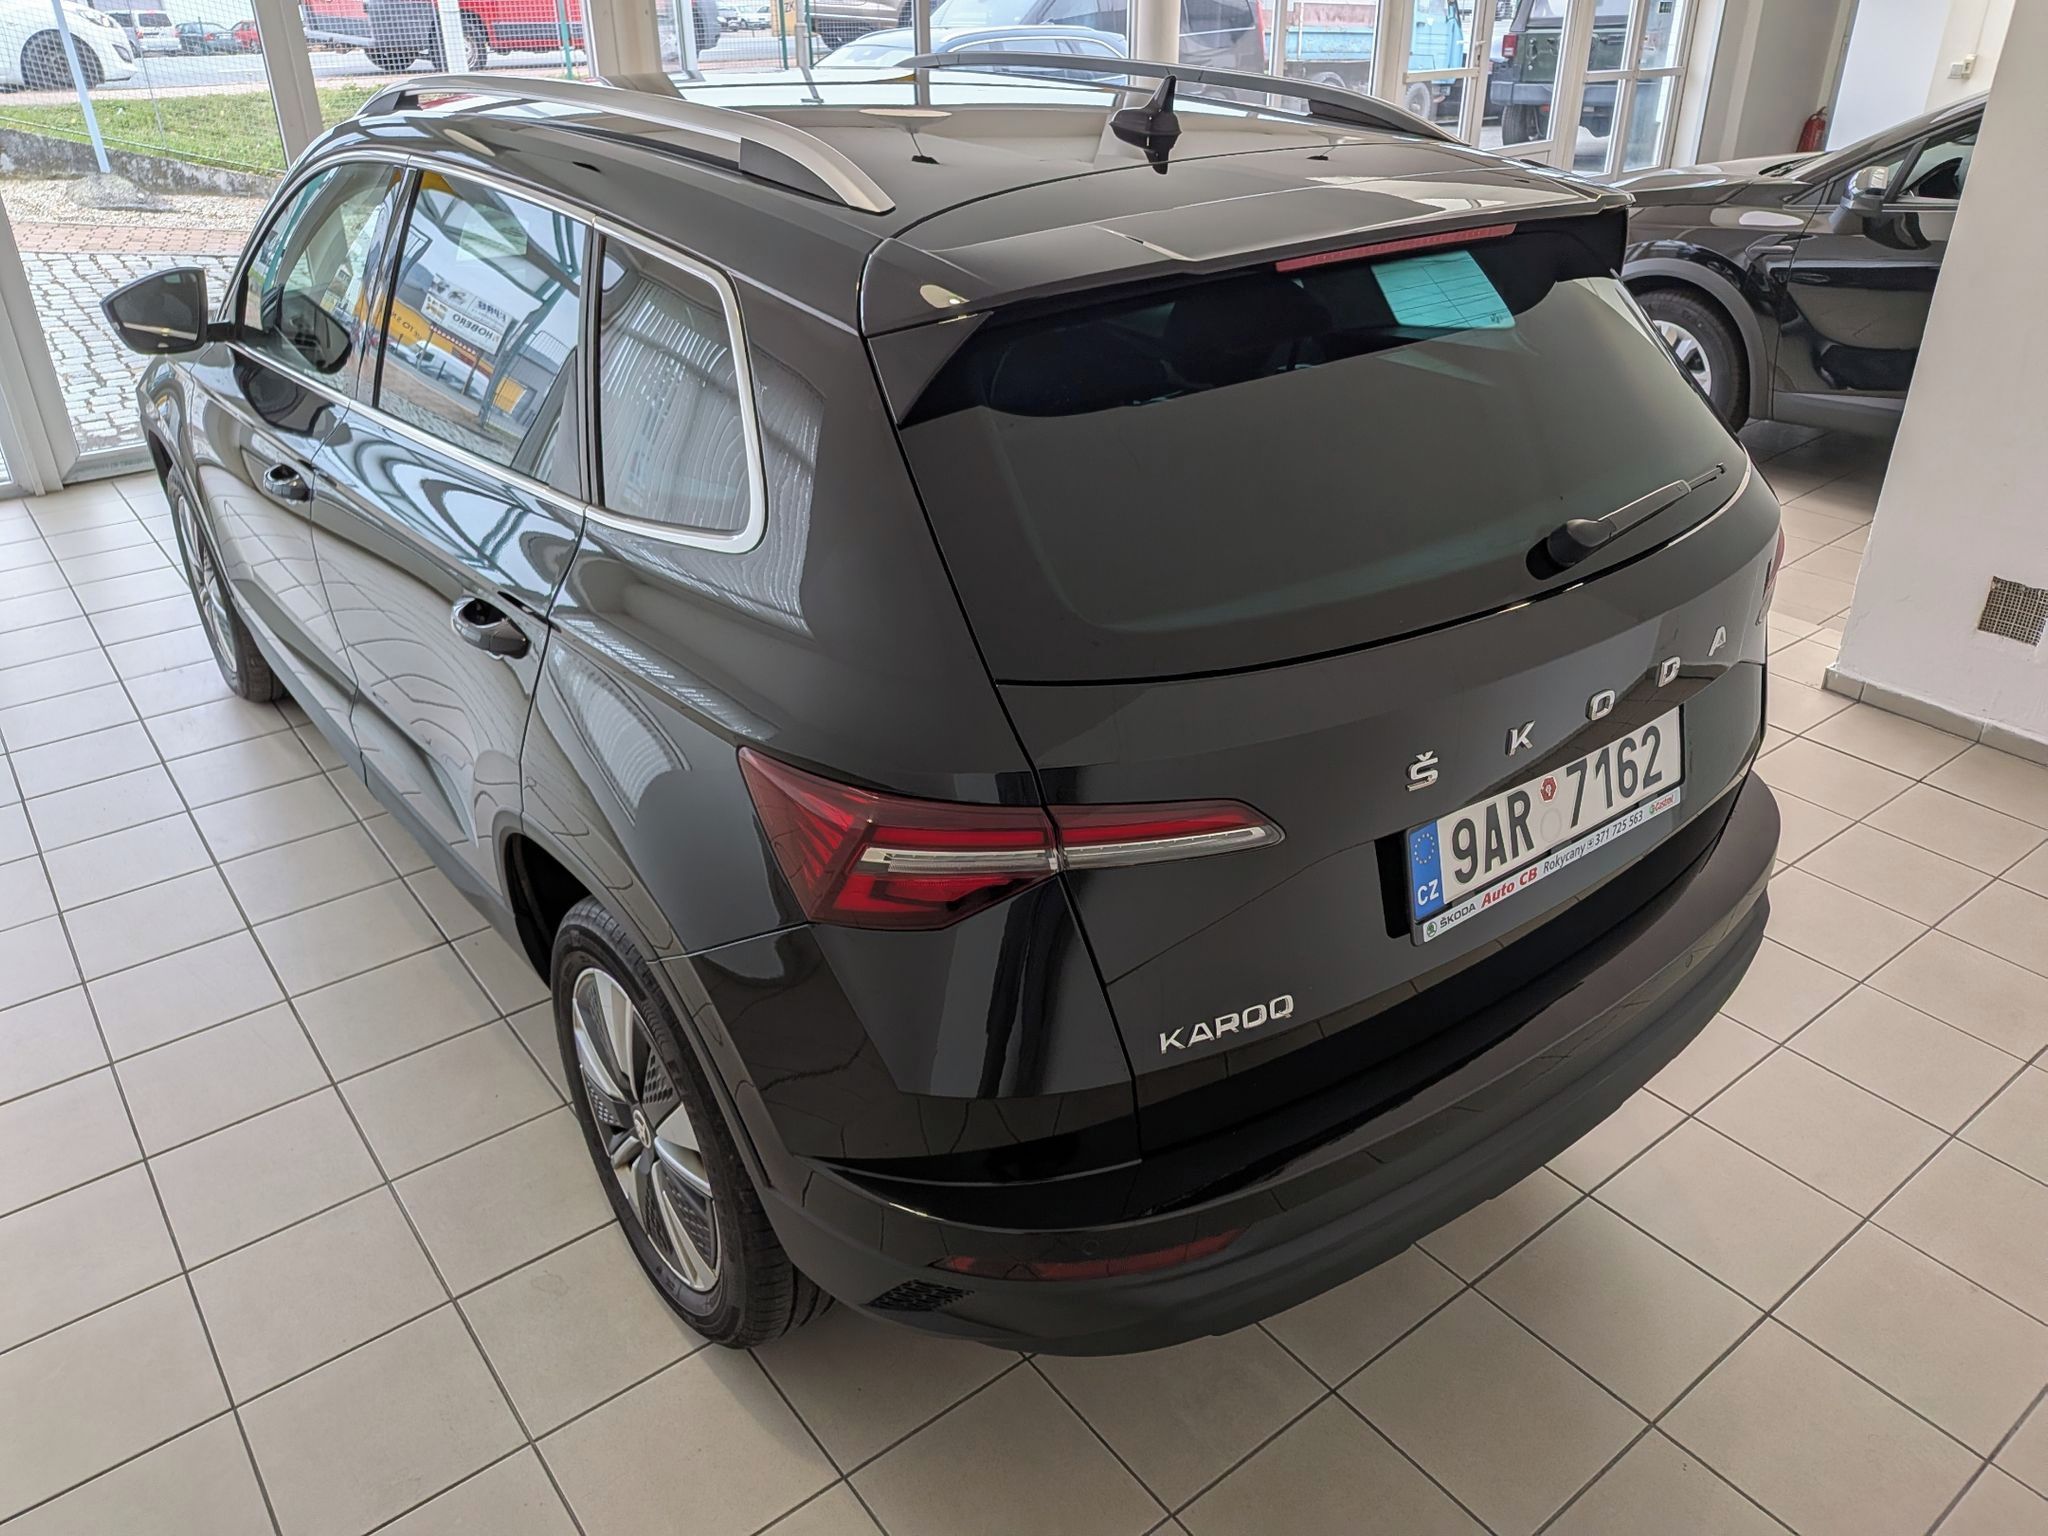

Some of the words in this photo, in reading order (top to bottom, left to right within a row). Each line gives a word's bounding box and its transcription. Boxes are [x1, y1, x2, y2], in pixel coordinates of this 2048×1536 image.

[1451, 790, 1536, 884] 9AR
[1565, 725, 1663, 828] 7162
[1417, 878, 1440, 906] CZ
[1439, 903, 1477, 929] ŠKODA
[1480, 881, 1516, 909] Auto
[1519, 867, 1539, 887] CB
[1542, 843, 1586, 874] Rokycany
[1612, 820, 1627, 837] 725
[1628, 810, 1644, 830] 563
[1159, 994, 1295, 1054] KAROQ
